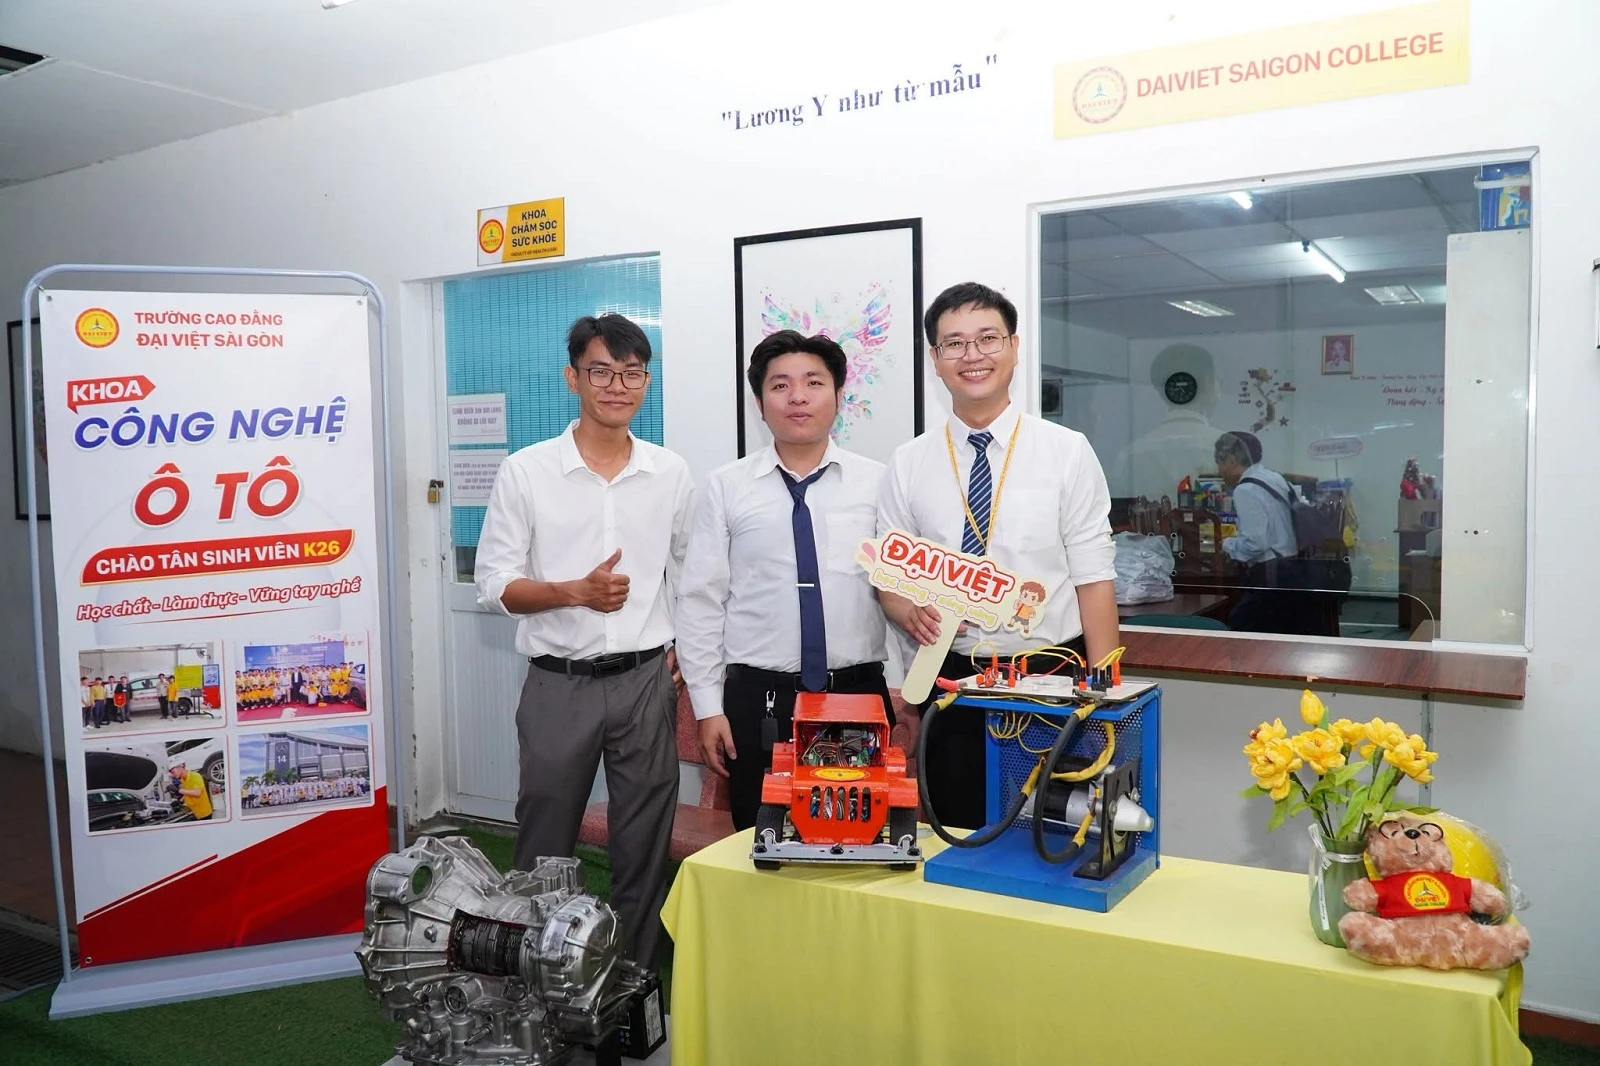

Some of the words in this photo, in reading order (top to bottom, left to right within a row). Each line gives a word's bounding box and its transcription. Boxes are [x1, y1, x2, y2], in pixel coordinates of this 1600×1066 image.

[1137, 65, 1224, 97] DAIVIET
[1229, 50, 1320, 83] SAIGON
[1328, 32, 1443, 68] COLLEGE
[812, 94, 828, 117] Y
[839, 88, 884, 112] như
[511, 222, 537, 235] CHĂM
[539, 218, 557, 231] SÓC
[521, 209, 547, 221] KHOA
[512, 235, 530, 248] SỨC
[134, 310, 201, 325] TRƯỜNG
[205, 313, 237, 325] CAO
[240, 309, 283, 326] ĐẲNG
[136, 332, 168, 350] ĐẠI
[172, 331, 210, 350] VIỆT
[214, 331, 242, 347] SÀI
[247, 332, 283, 347] GÒN
[72, 380, 143, 402] KHOA
[74, 406, 215, 449] CÔNG
[228, 396, 347, 442] NGHỆ
[134, 462, 190, 526] Ô
[214, 455, 300, 520] TÔ
[96, 552, 154, 575] CHÀO
[158, 551, 198, 569] TÂN
[202, 548, 251, 566] SINH
[254, 541, 299, 562] VIÊN
[303, 540, 340, 557] K26
[887, 540, 940, 574] ĐẠI
[948, 559, 1009, 598] VIỆT
[77, 604, 111, 622] Học
[112, 596, 151, 618] chất
[162, 593, 198, 613] Làm
[202, 591, 238, 611] thực
[249, 585, 291, 604] Vững
[293, 584, 318, 600] tay
[320, 577, 362, 597] nghề
